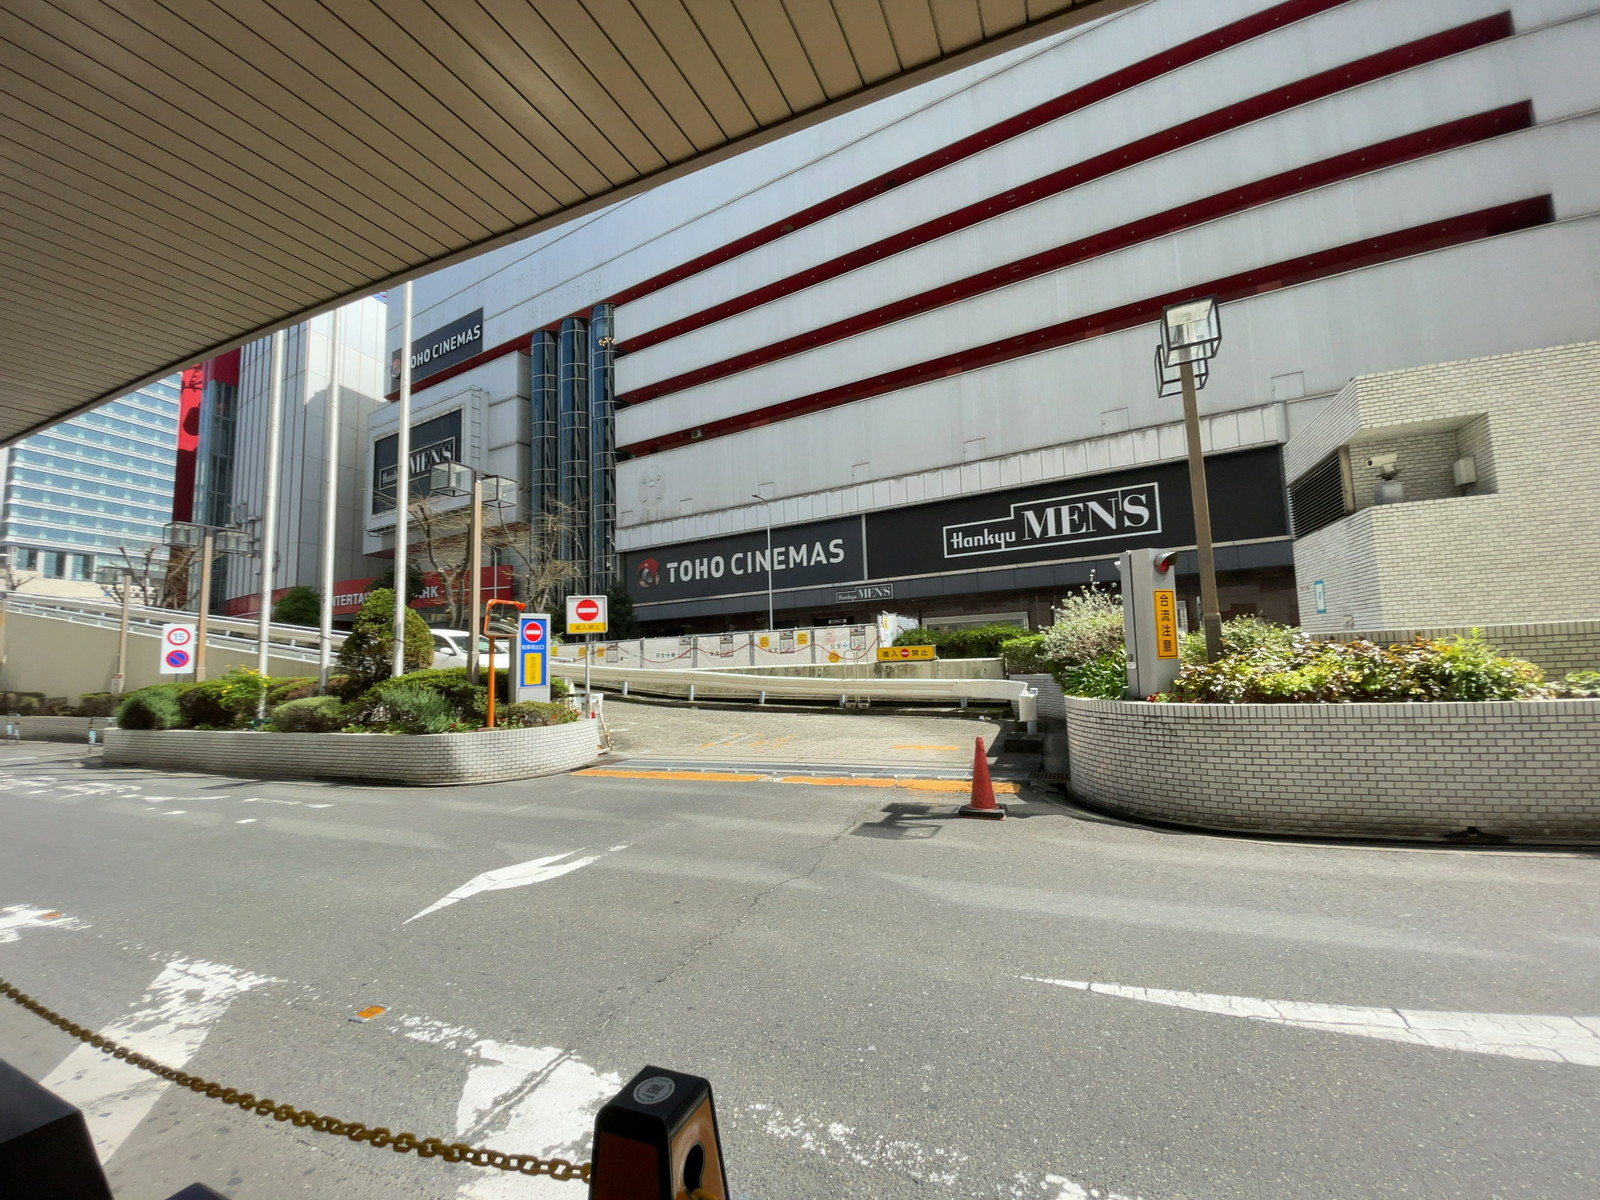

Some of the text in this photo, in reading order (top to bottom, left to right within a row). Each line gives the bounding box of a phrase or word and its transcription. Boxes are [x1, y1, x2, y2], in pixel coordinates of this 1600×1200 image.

[411, 324, 481, 369] OHO CINEMAS
[950, 490, 1150, 550] Hankyu MEN'S
[666, 539, 845, 583] TOHO CINEMAS
[173, 632, 185, 641] 15
[1159, 593, 1173, 653] 合流注意
